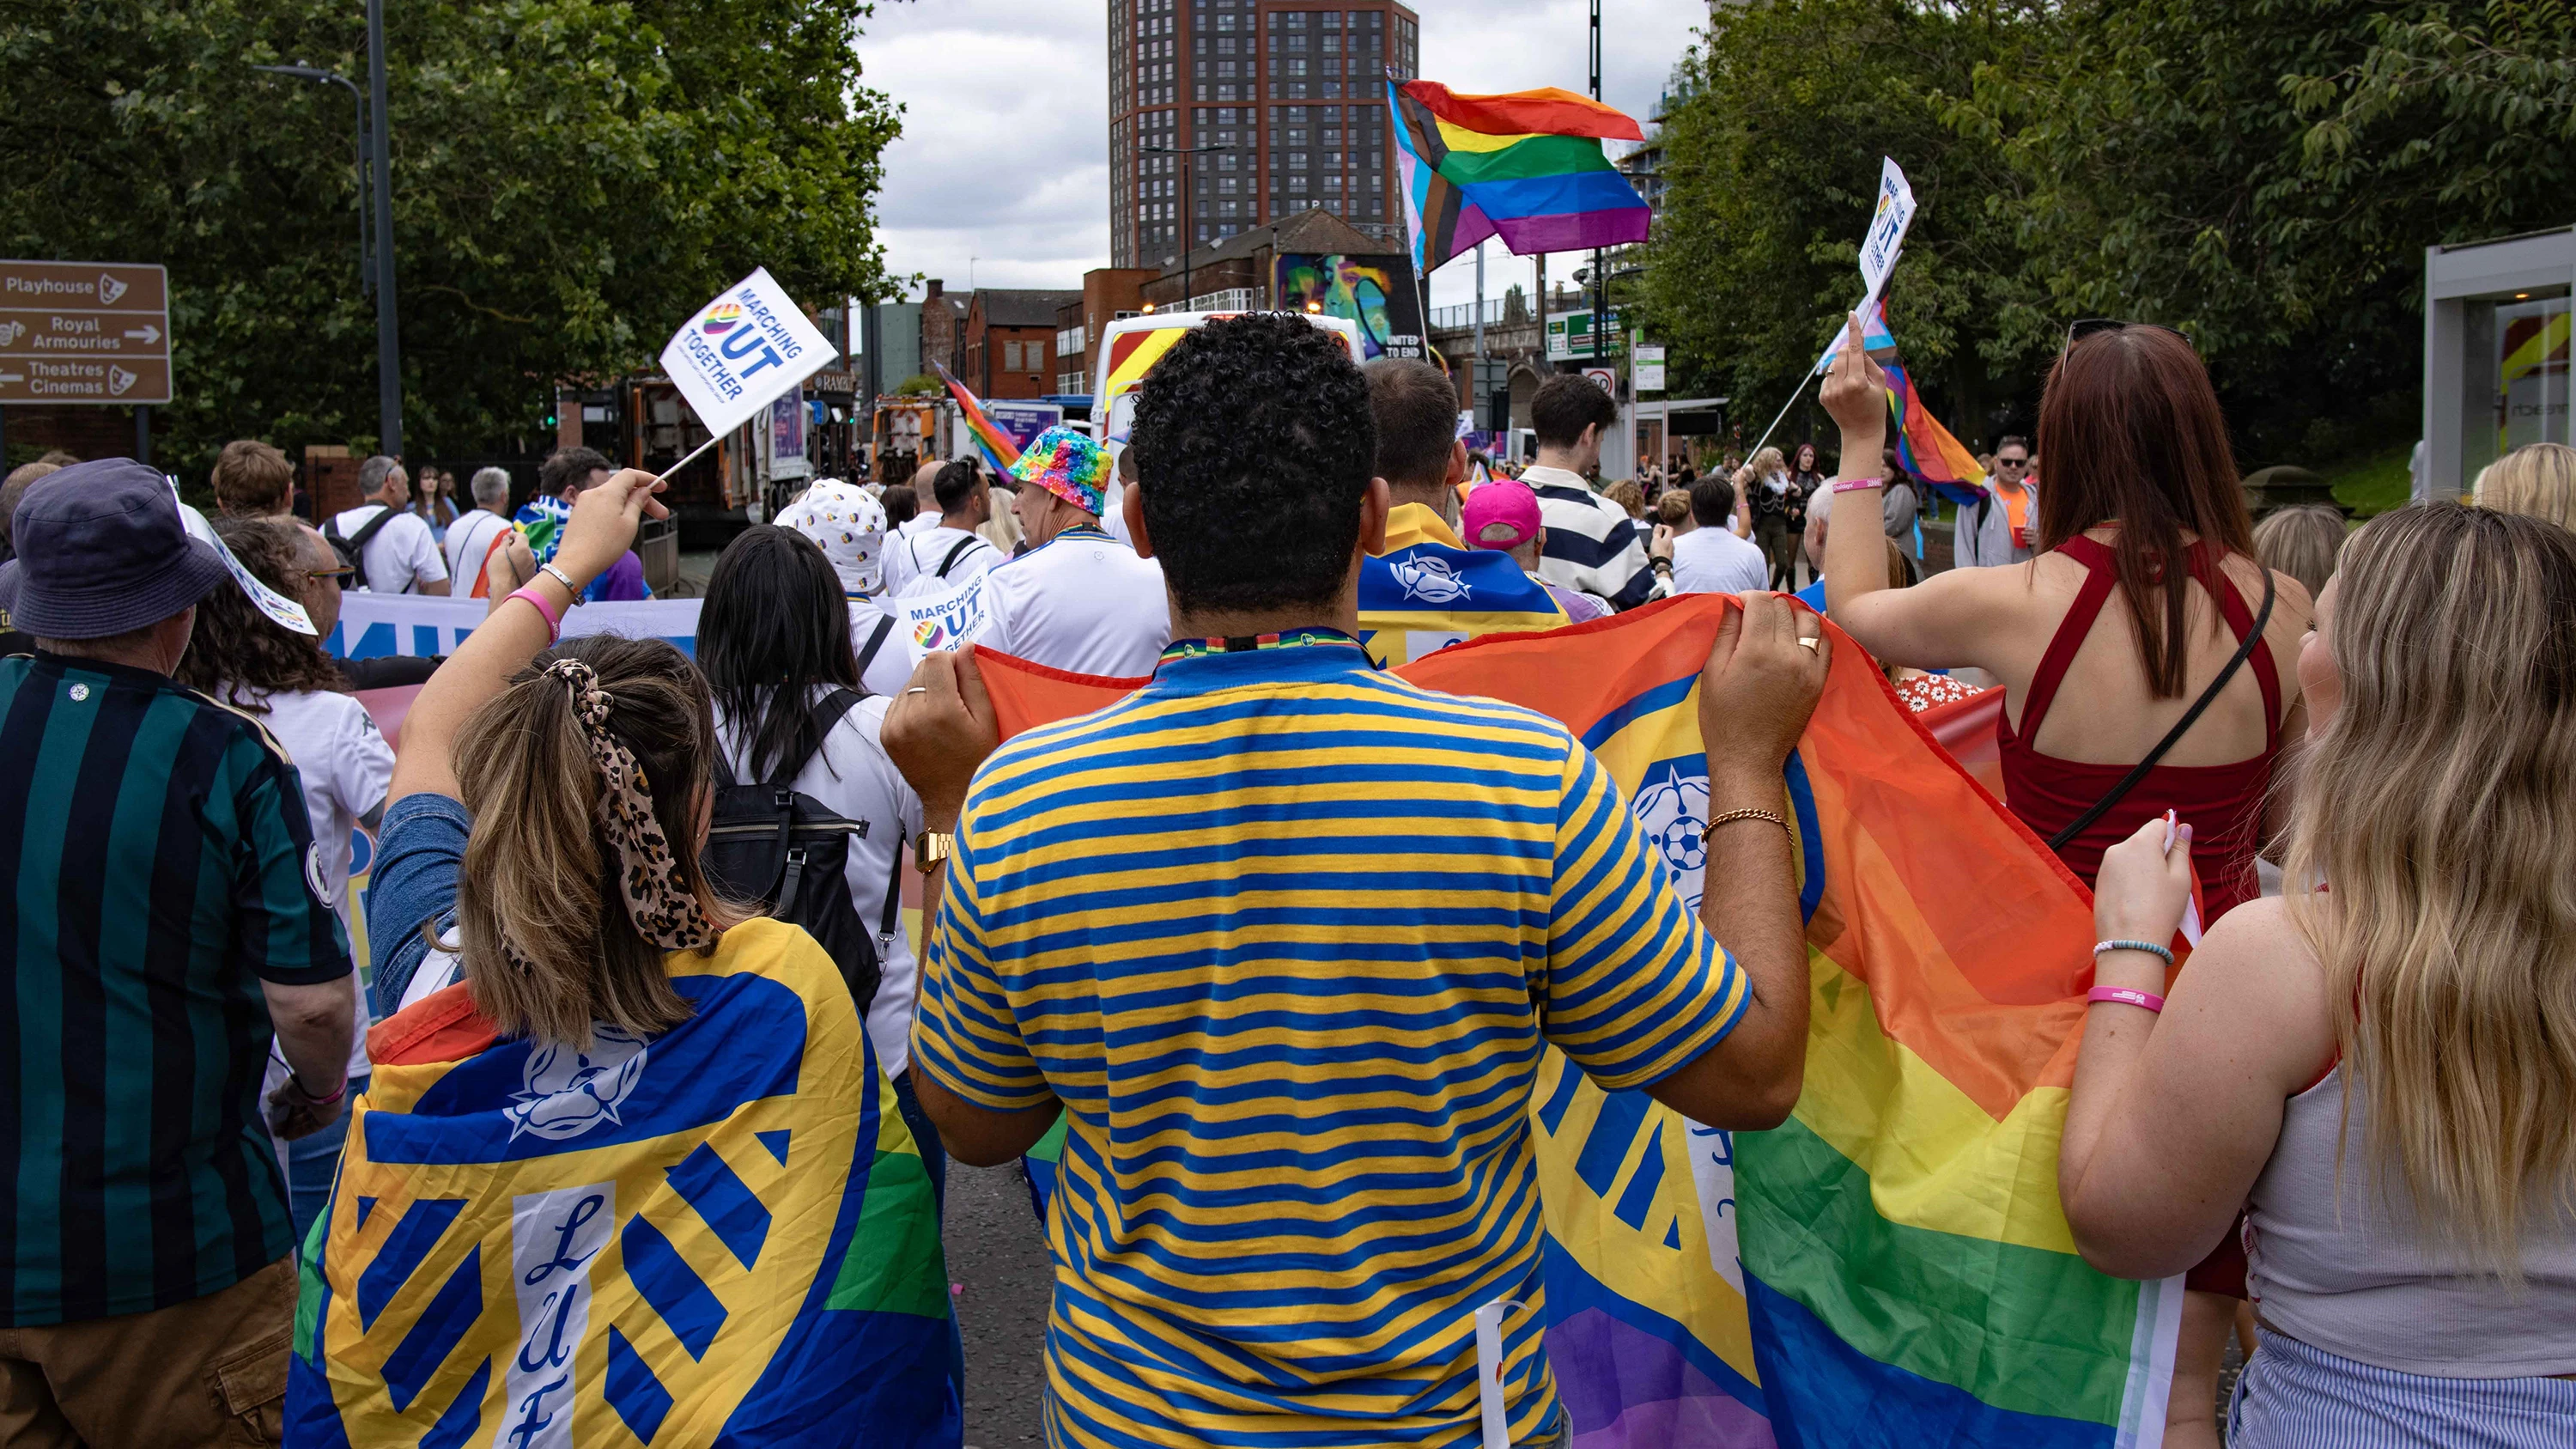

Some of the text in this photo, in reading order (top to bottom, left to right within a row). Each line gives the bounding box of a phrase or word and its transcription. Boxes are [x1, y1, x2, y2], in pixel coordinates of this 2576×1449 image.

[6, 277, 94, 295] Playhouse
[52, 317, 100, 334] Royal
[736, 288, 803, 359] MARCHING
[33, 334, 121, 350] Armouries
[1386, 335, 1419, 345] UNITED
[1386, 347, 1420, 357] TO END
[27, 361, 104, 376] Theatres
[683, 328, 743, 401] TOGETHER
[30, 379, 104, 394] Cinemas
[910, 575, 982, 620] MARCHING
